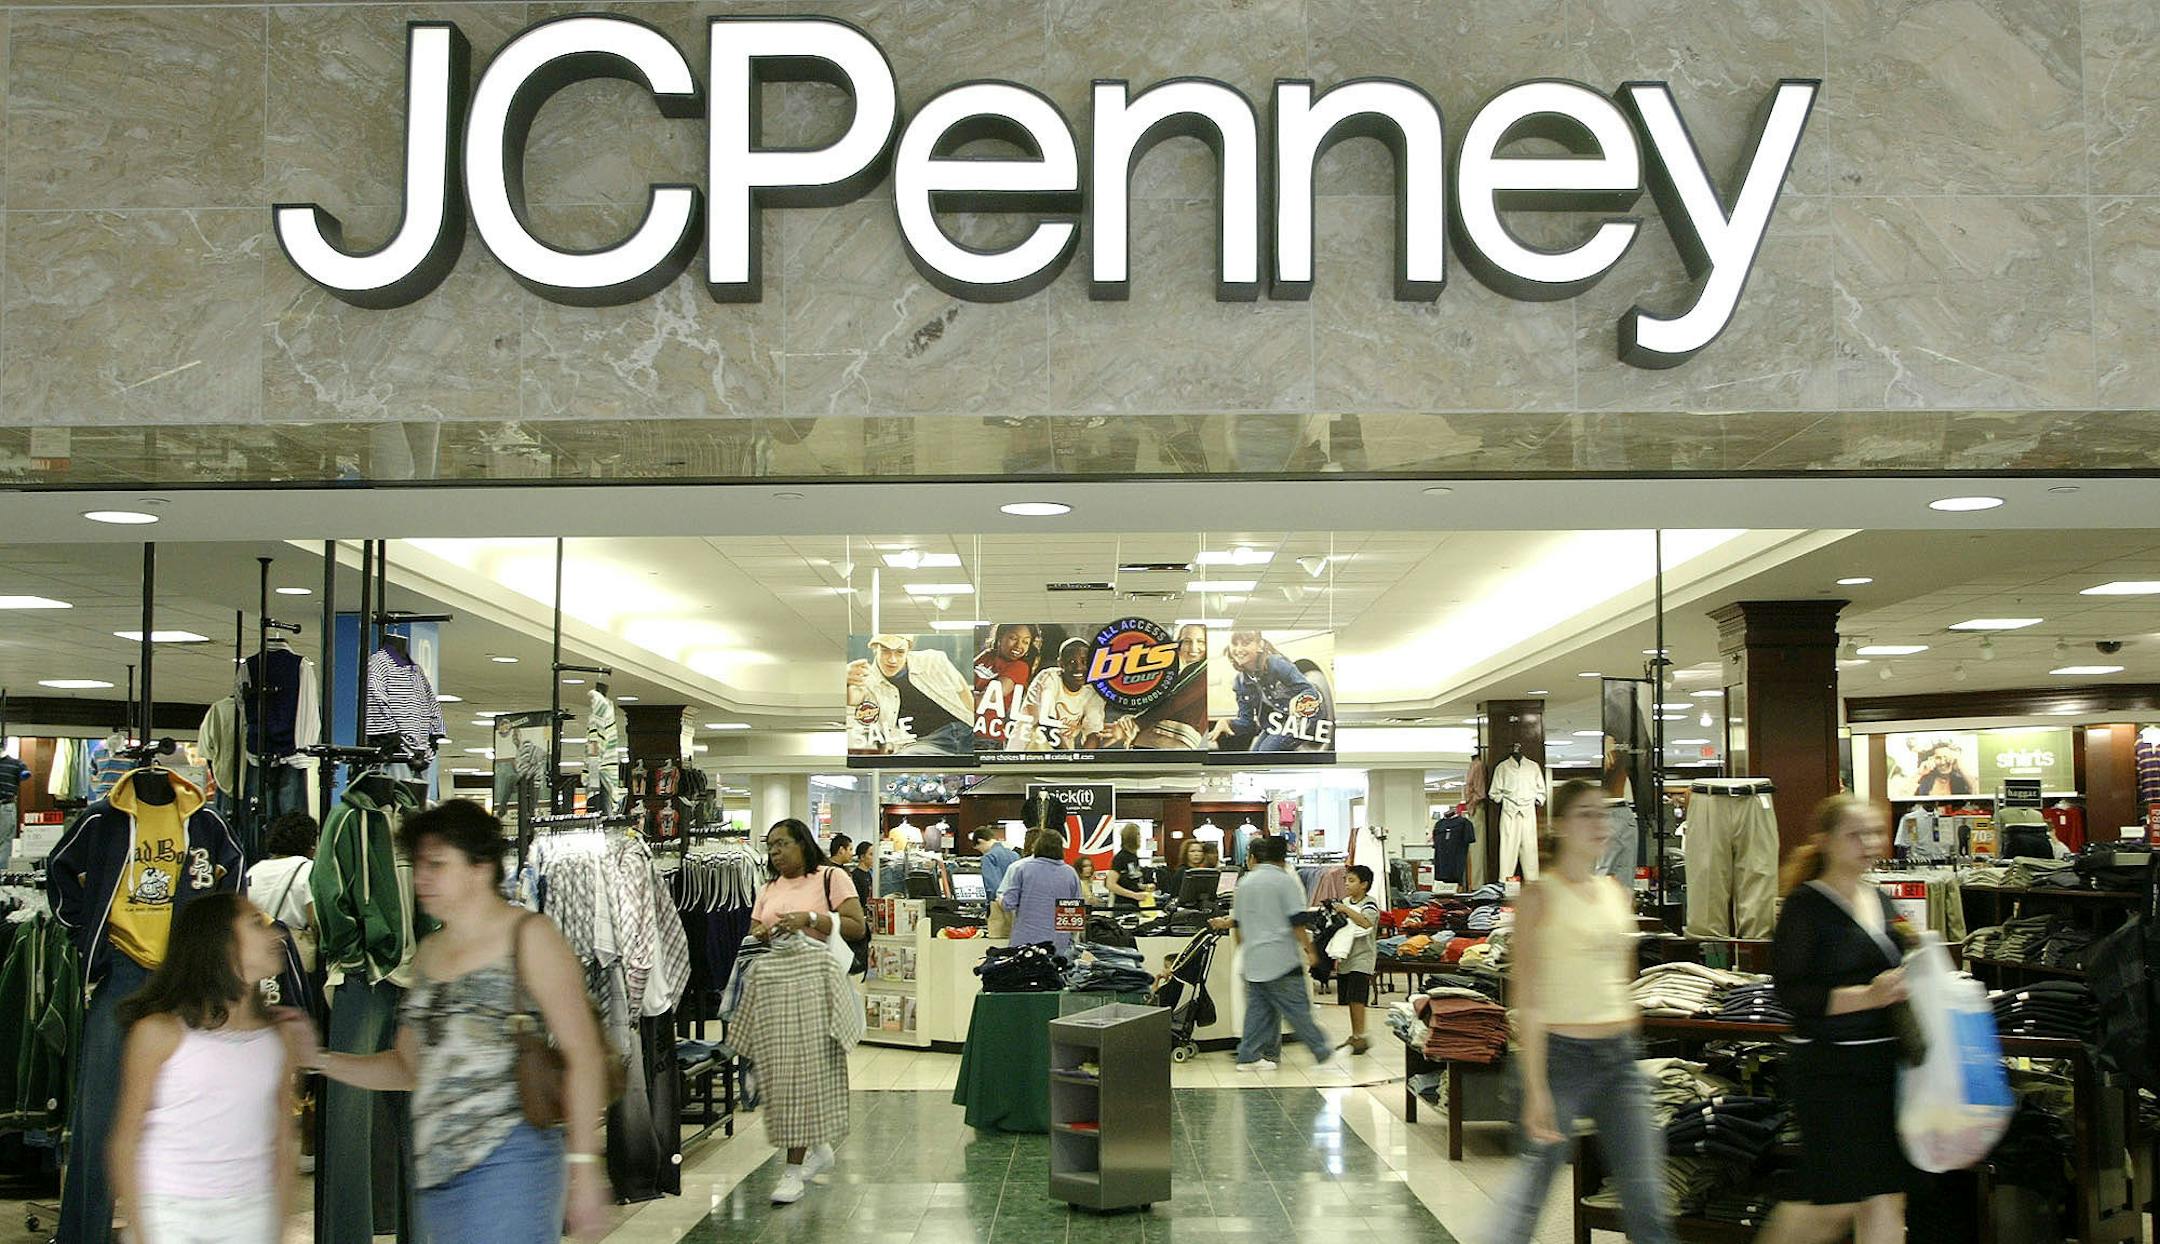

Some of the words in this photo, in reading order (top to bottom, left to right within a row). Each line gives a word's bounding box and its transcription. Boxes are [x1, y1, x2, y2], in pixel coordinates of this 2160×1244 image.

[274, 18, 1820, 366] JCPenney
[1096, 625, 1118, 645] ALL
[1121, 619, 1167, 641] ACCESS
[1086, 642, 1180, 683] bts
[1123, 671, 1160, 685] tour
[975, 679, 1064, 729] ALL
[1096, 682, 1118, 702] BACK
[1119, 697, 1129, 705] TO
[972, 715, 1061, 748] ACCESS
[1266, 711, 1335, 744] SALE
[1995, 749, 2055, 768] shirts
[1049, 788, 1095, 806] ick(it)
[1055, 916, 1084, 926] 26.99
